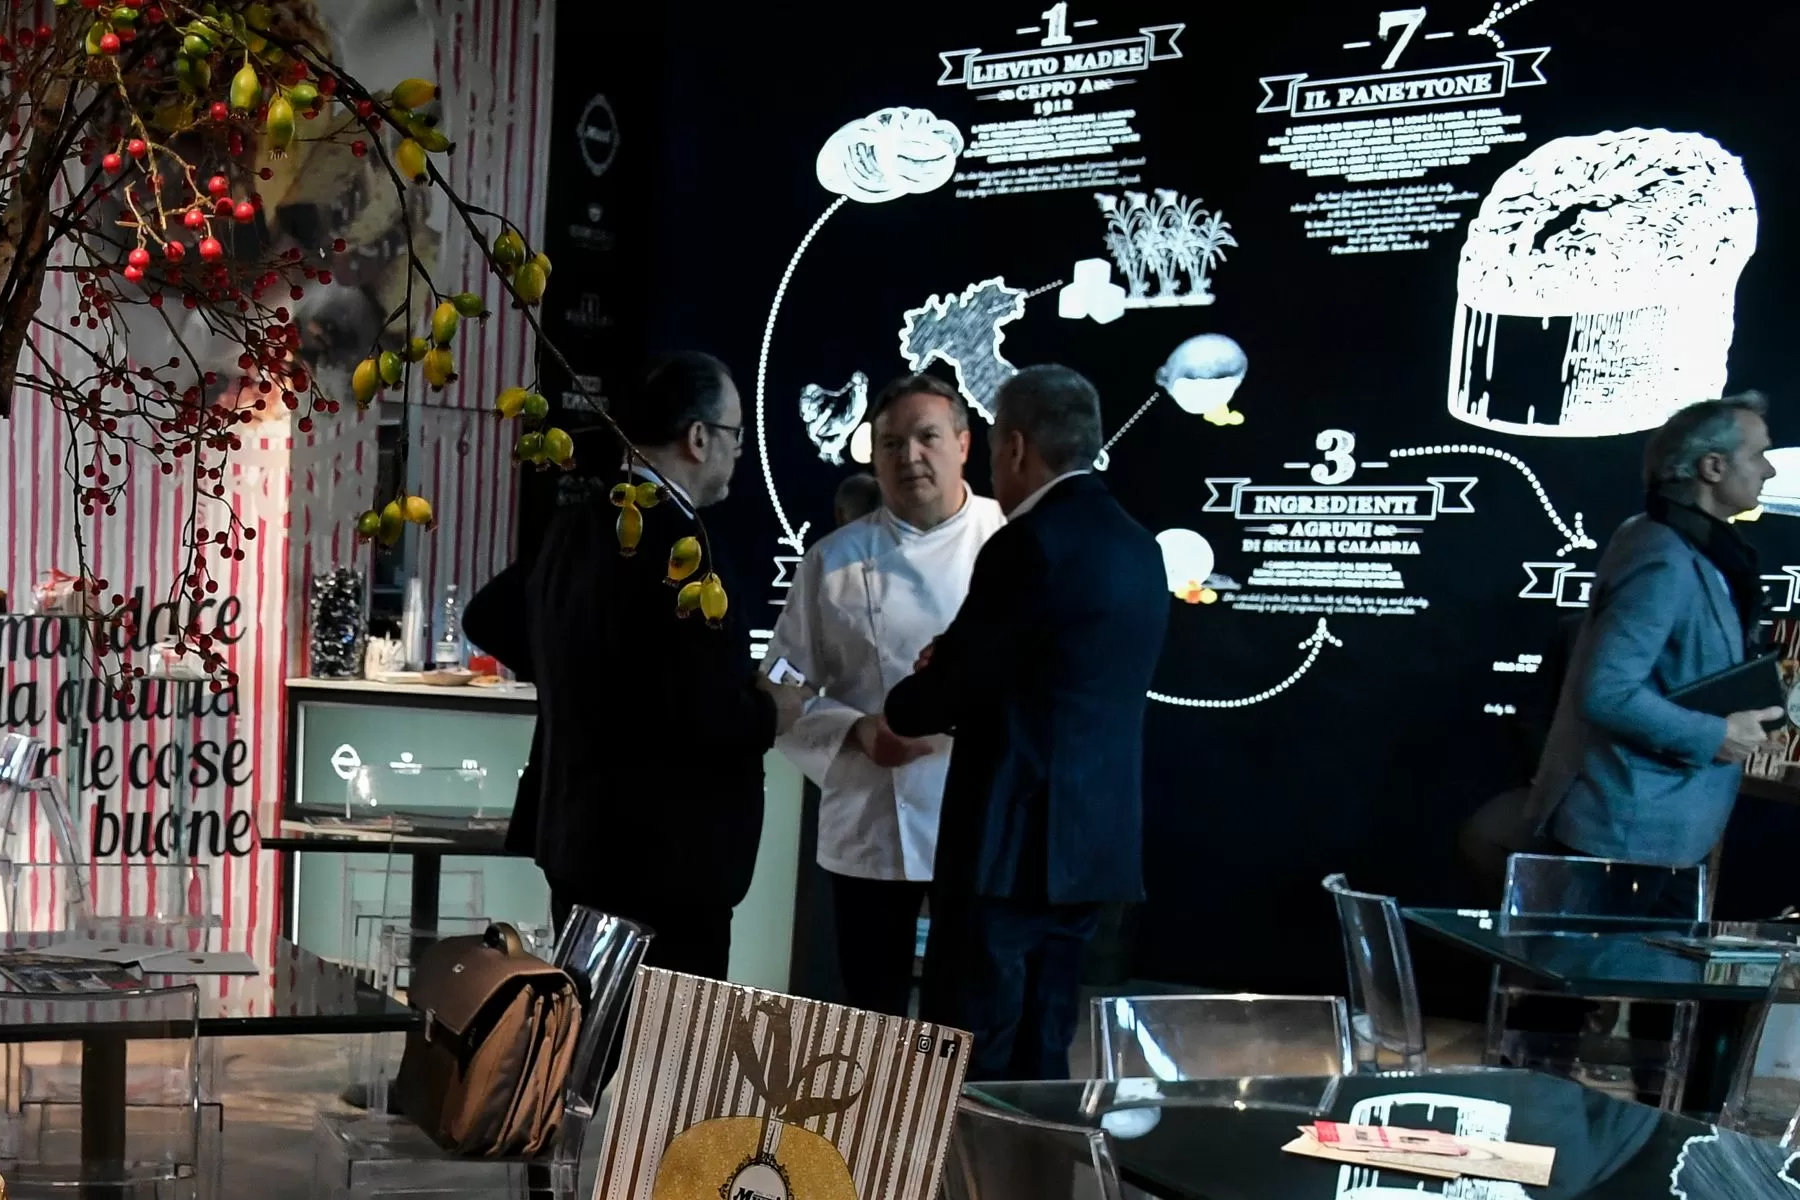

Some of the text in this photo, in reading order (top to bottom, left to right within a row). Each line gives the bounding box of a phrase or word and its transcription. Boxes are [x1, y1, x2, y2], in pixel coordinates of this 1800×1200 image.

[1041, 1, 1072, 46] 1
[1378, 6, 1426, 70] 7
[973, 47, 1144, 83] LIEVITO MADRE
[1016, 80, 1076, 101] CEPPO
[1033, 99, 1073, 116] 1912
[1304, 73, 1492, 110] IL PANETTONE
[1310, 429, 1356, 485] 3
[1253, 495, 1417, 515] INGREDIENTI
[1242, 539, 1421, 555] DI SICILIA E CALABRIA
[1289, 522, 1373, 537] AGRUMI
[78, 728, 119, 791] le
[128, 738, 254, 790] cose
[93, 796, 256, 858] buone
